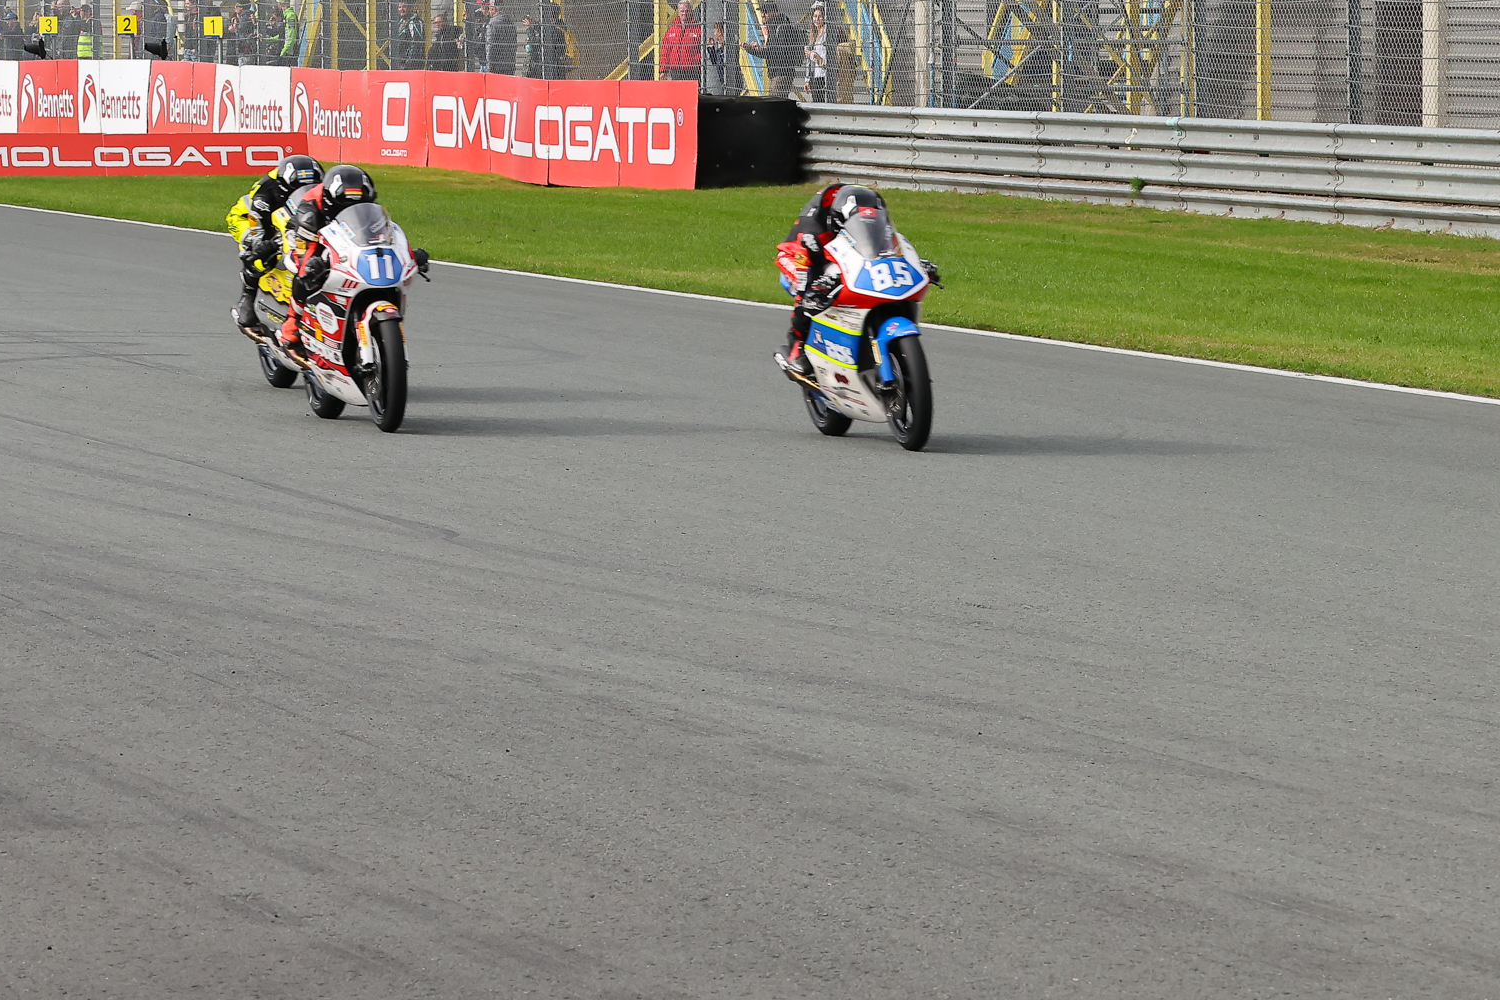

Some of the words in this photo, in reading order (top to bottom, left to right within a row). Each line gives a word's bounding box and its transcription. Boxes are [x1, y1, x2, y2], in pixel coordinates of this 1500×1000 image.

[45, 18, 53, 31] 3
[124, 17, 132, 31] 2
[210, 19, 215, 33] 1
[37, 86, 75, 118] Bennetts
[100, 88, 141, 120] Bennetts
[169, 90, 209, 126] Bennetts
[239, 95, 283, 132] Bennetts
[312, 99, 363, 140] Bennetts
[364, 254, 395, 280] 11
[867, 260, 915, 291] 85
